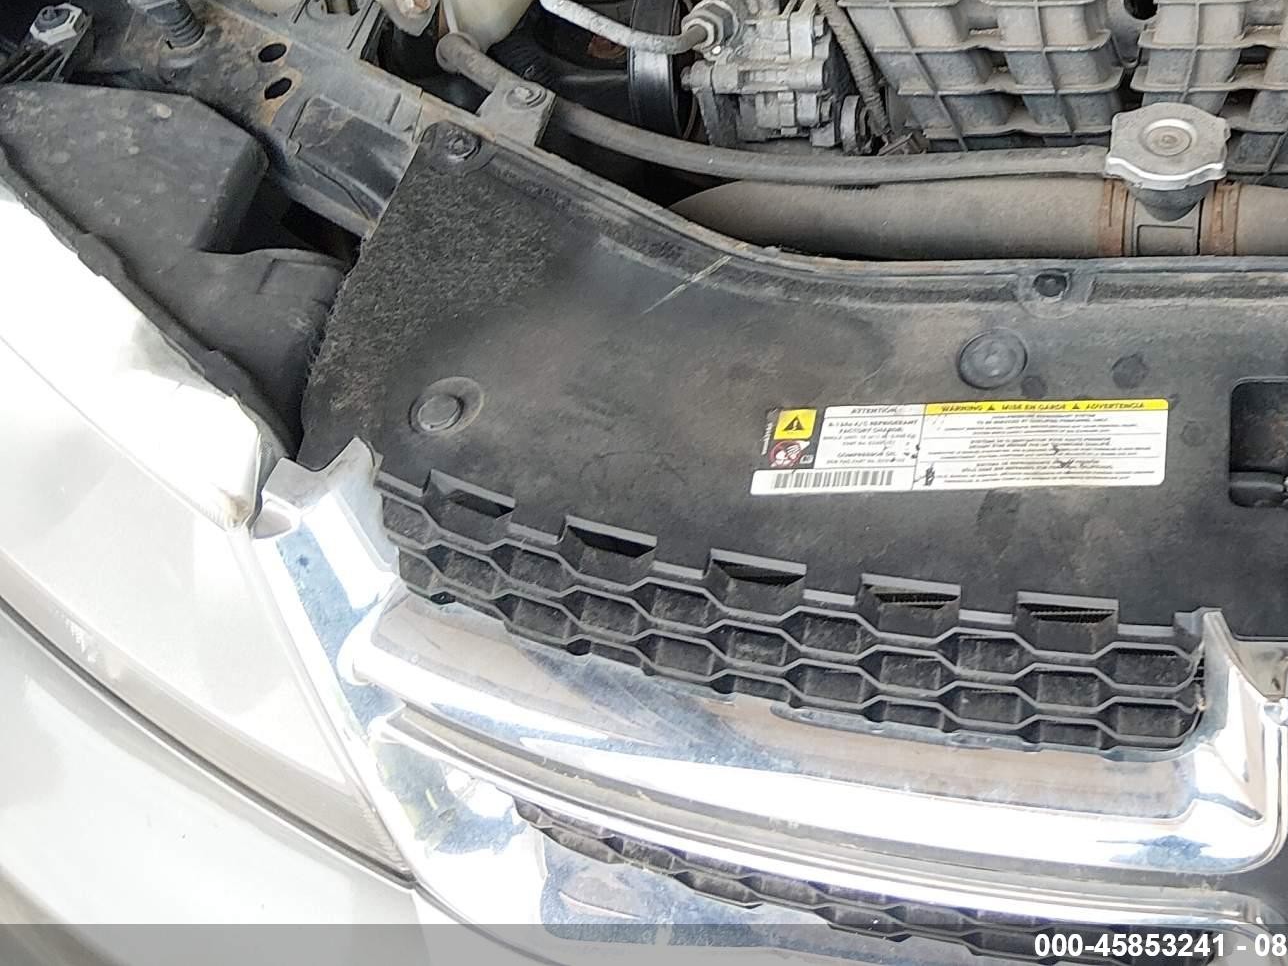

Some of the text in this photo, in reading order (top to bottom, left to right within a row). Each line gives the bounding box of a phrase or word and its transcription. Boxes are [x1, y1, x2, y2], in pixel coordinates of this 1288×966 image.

[850, 405, 898, 415] ATTENTION
[941, 404, 983, 413] WARNING
[1024, 403, 1036, 411] EN
[1085, 401, 1145, 410] ADVERTENCIA
